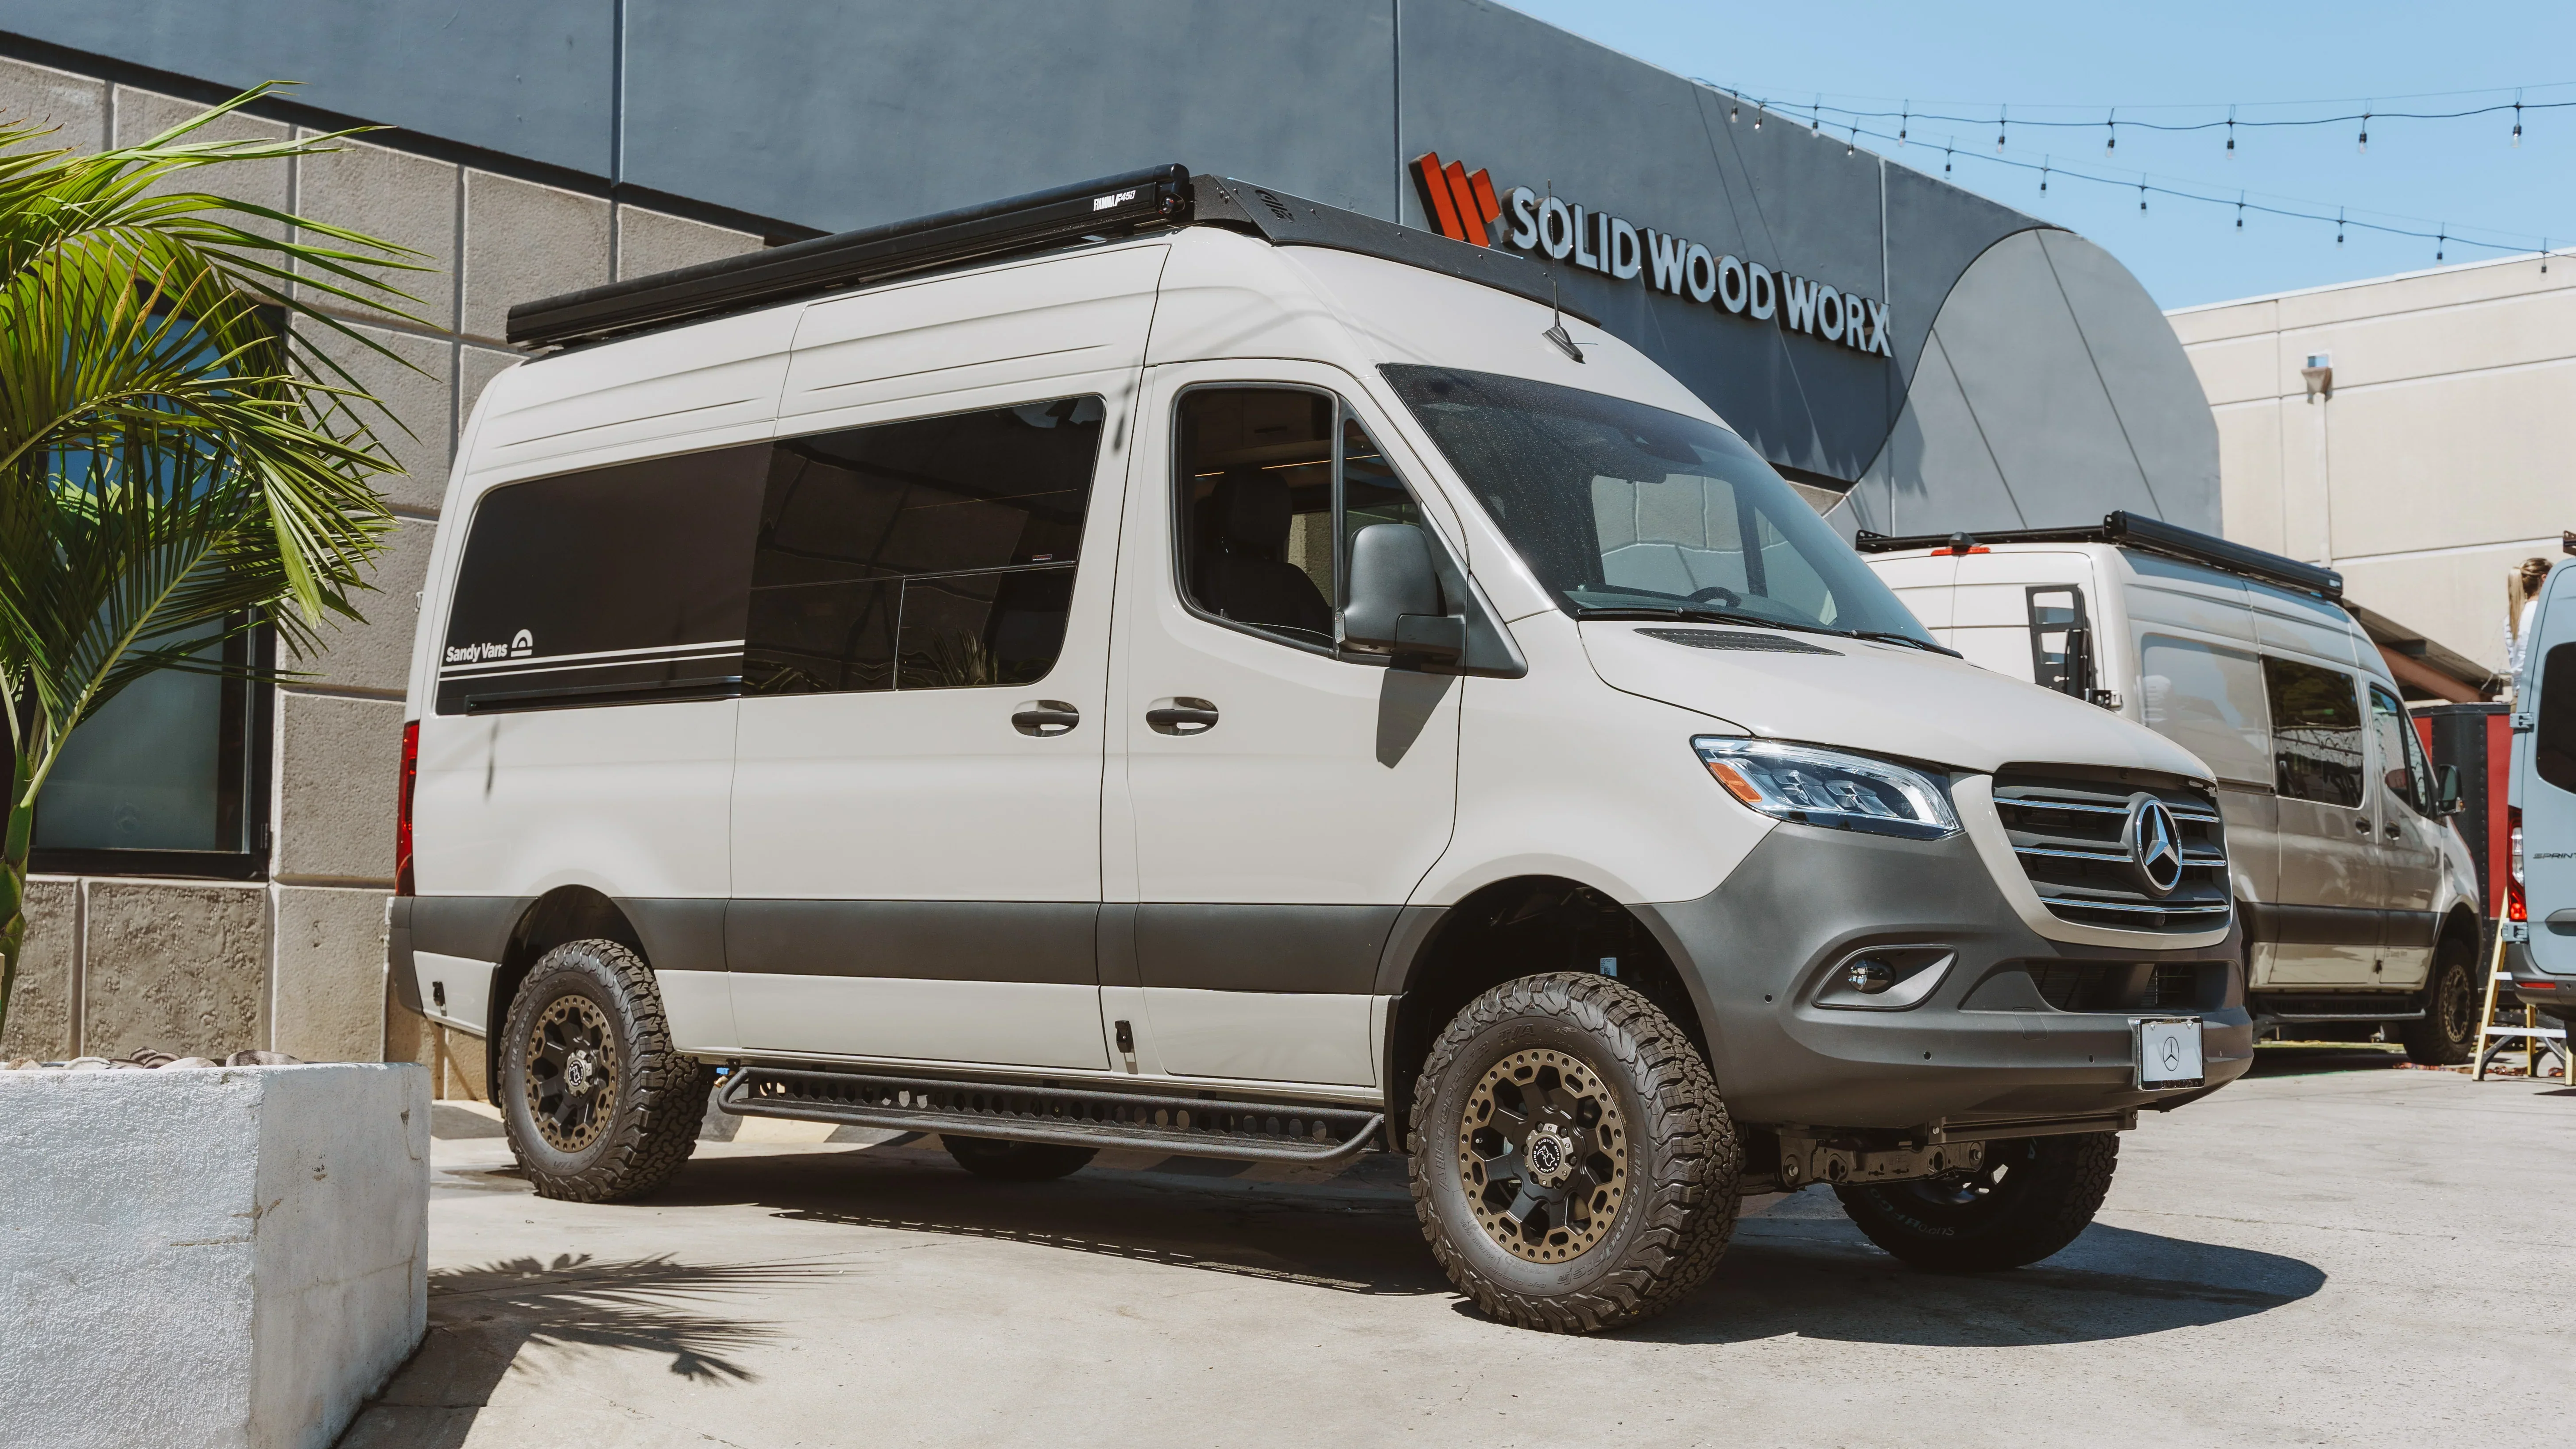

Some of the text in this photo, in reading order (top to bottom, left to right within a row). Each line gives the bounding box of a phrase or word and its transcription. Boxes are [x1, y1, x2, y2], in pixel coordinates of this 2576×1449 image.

[1093, 195, 1115, 211] FIAMMA
[1509, 185, 1641, 280] SOLID
[1781, 270, 1893, 357] WORX
[446, 642, 508, 663] Sandy Vans
